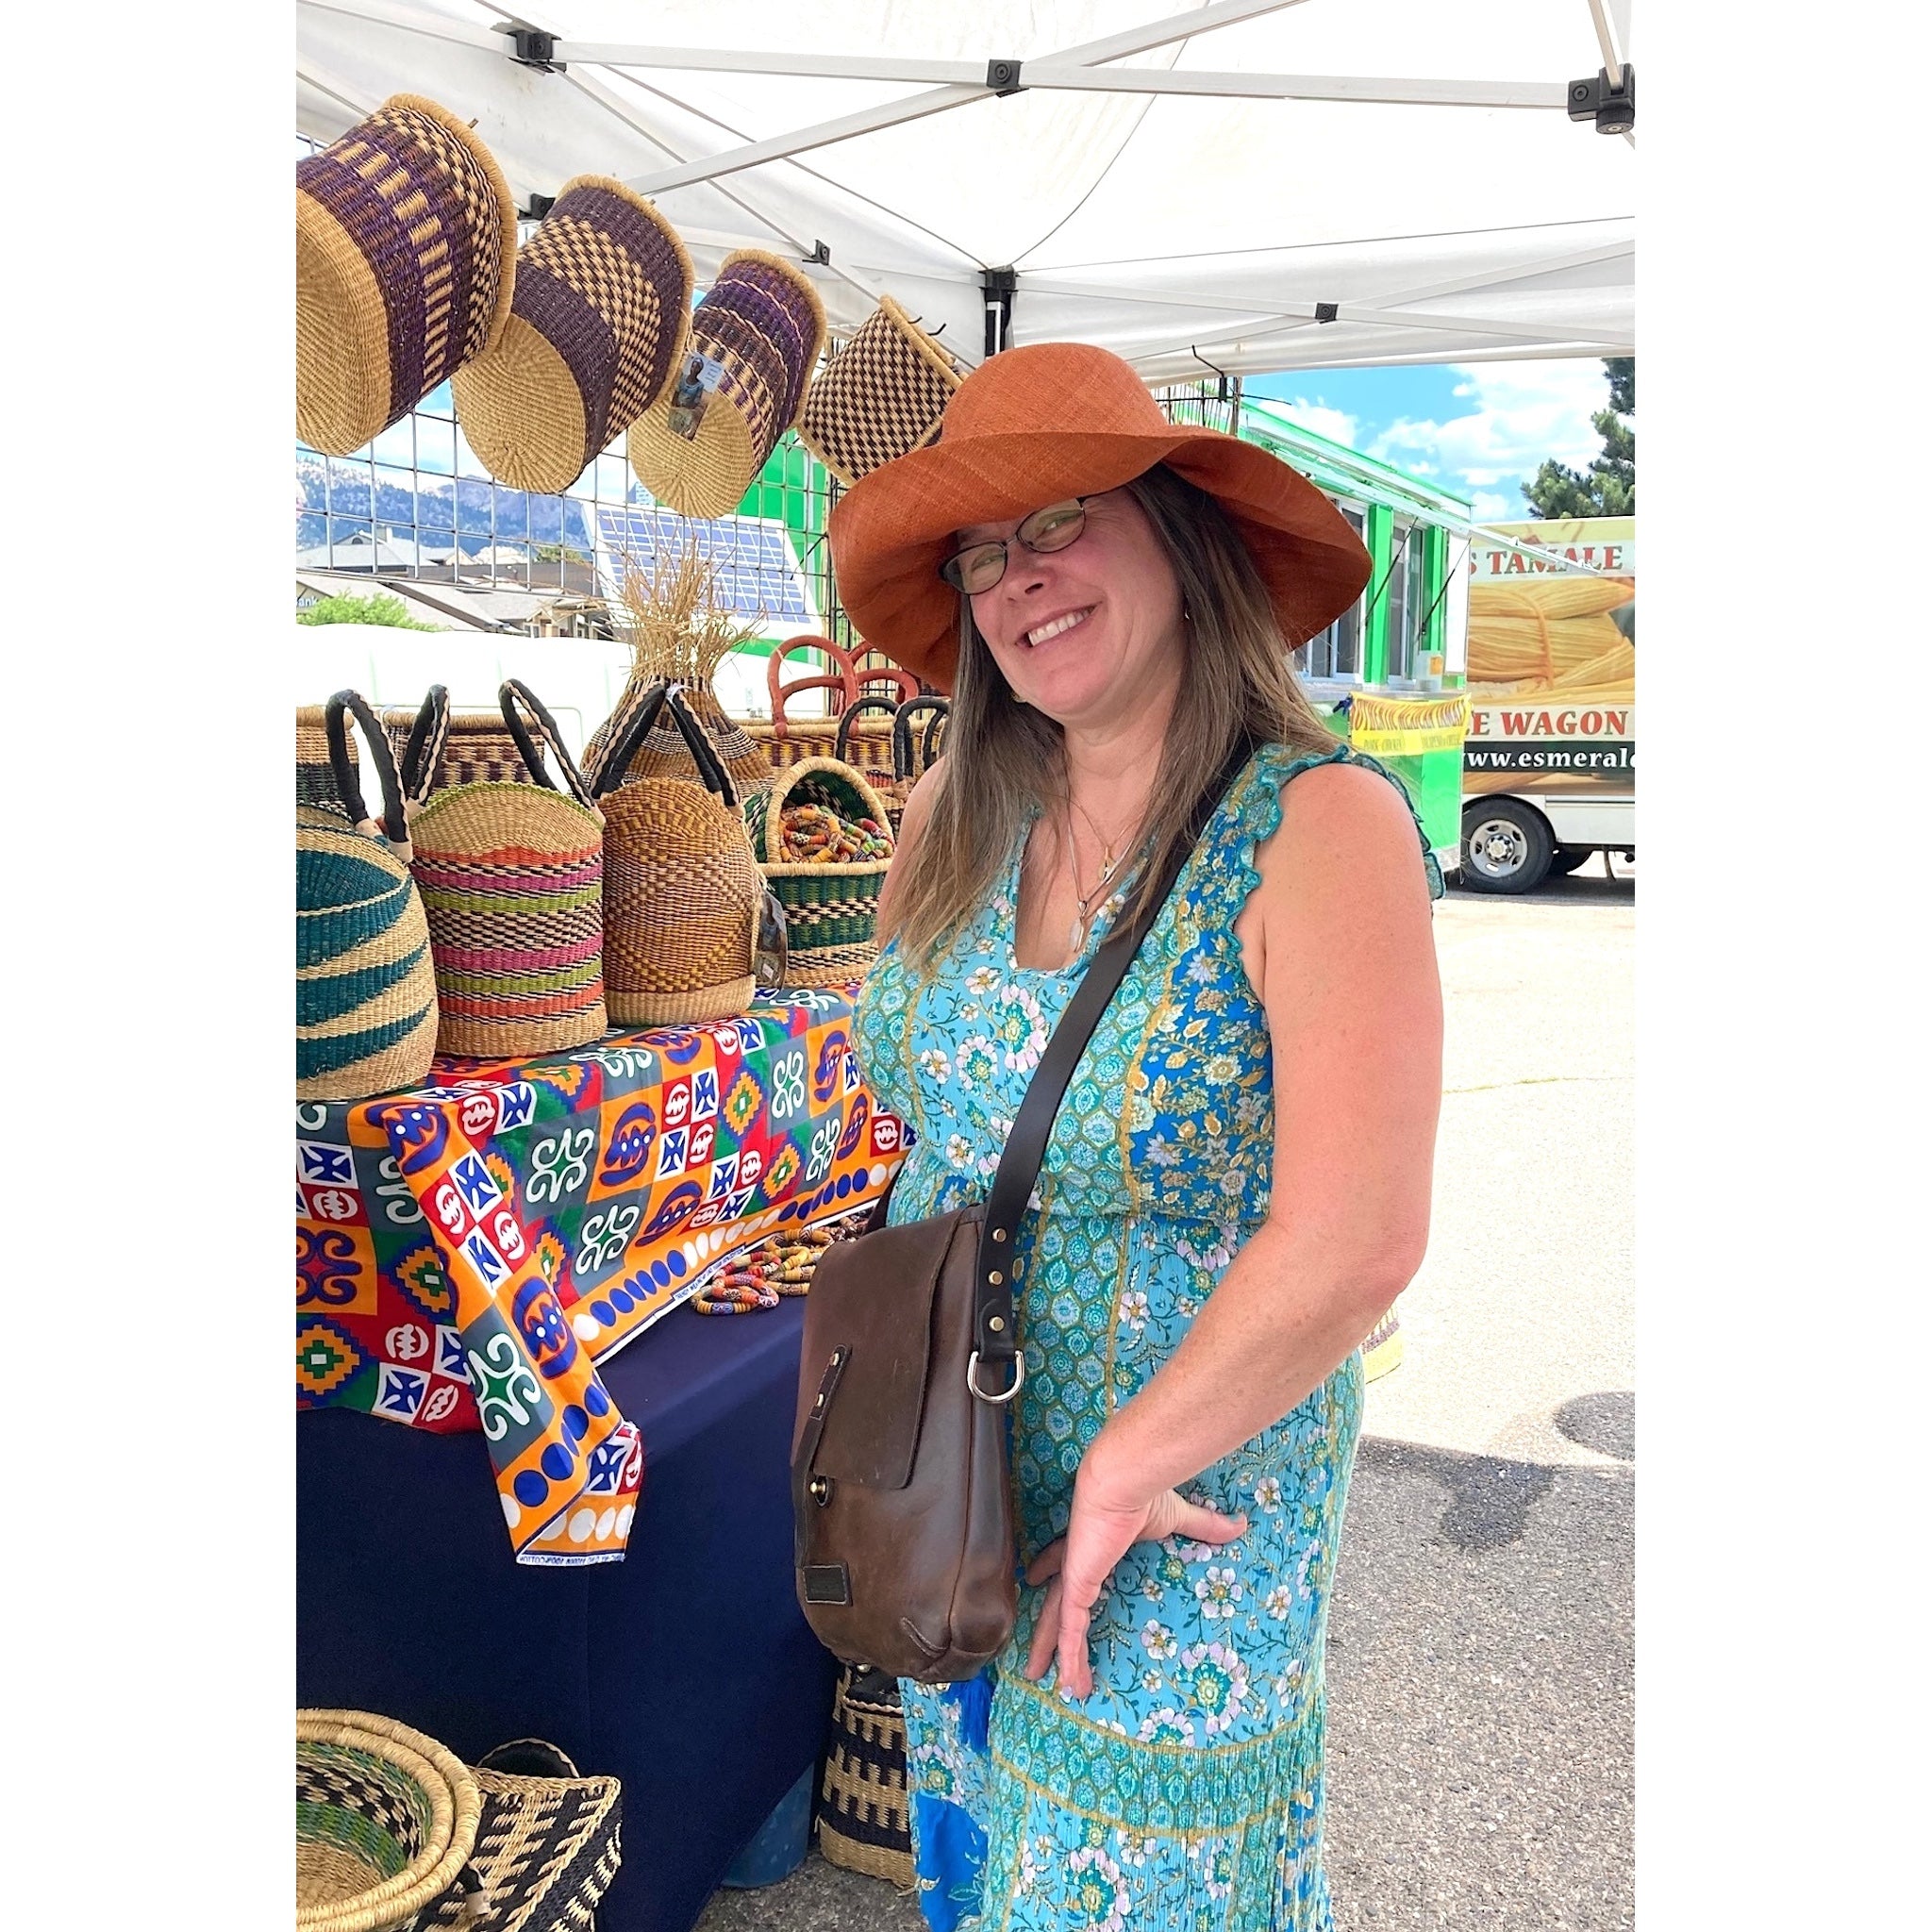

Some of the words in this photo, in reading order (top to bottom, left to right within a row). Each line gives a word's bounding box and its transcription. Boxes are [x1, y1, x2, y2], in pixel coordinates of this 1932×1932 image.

[1466, 712, 1491, 736] E
[1500, 710, 1629, 736] WAGON
[1462, 747, 1635, 768] ww.esmeral
